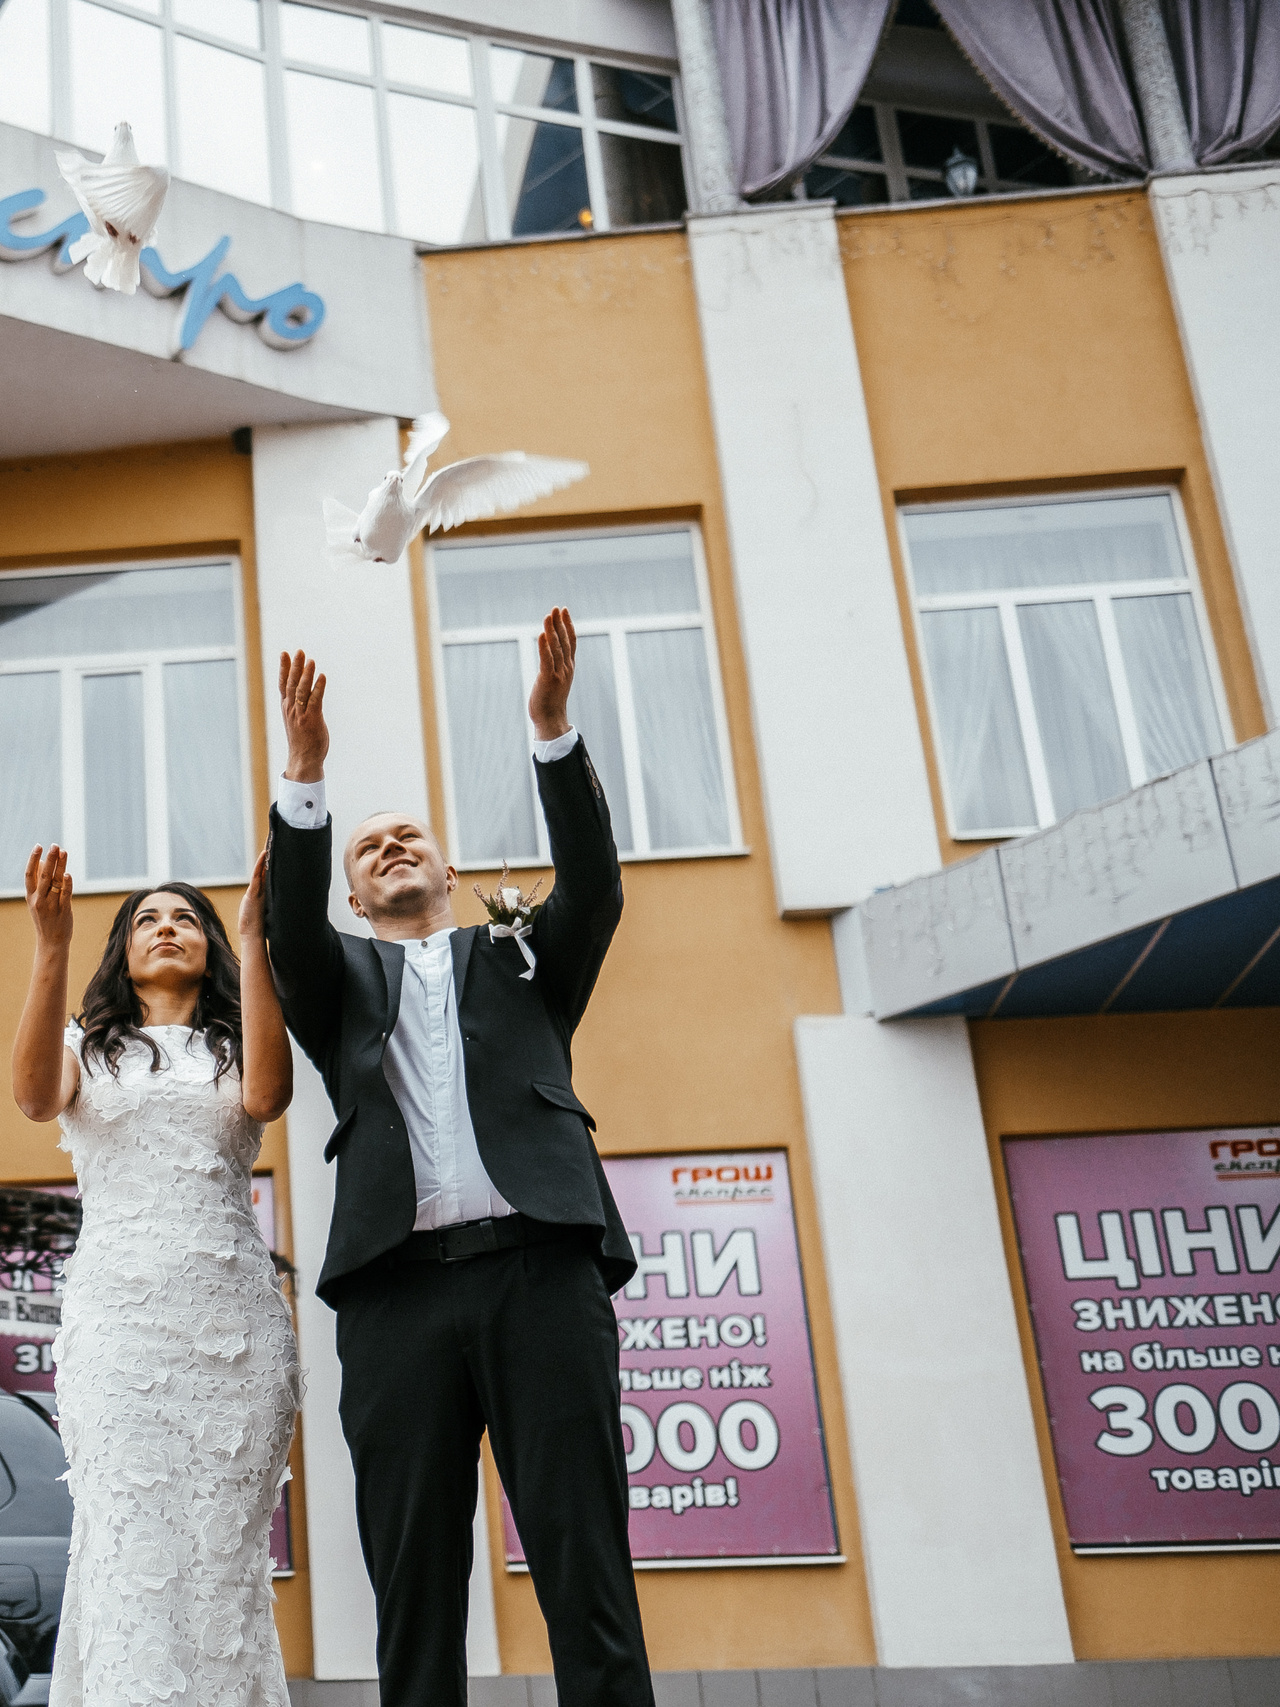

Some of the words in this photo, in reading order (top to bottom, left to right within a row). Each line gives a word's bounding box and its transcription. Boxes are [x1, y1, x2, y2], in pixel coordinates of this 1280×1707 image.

[671, 1165, 773, 1185] ГРОШ
[623, 1228, 762, 1299] НИ
[1071, 1291, 1280, 1331] ЗНИЖЕН
[708, 1358, 773, 1389] ніж
[1080, 1349, 1124, 1373] на
[1131, 1342, 1263, 1371] більше
[1088, 1381, 1280, 1456] 300
[1150, 1458, 1280, 1496] товарі
